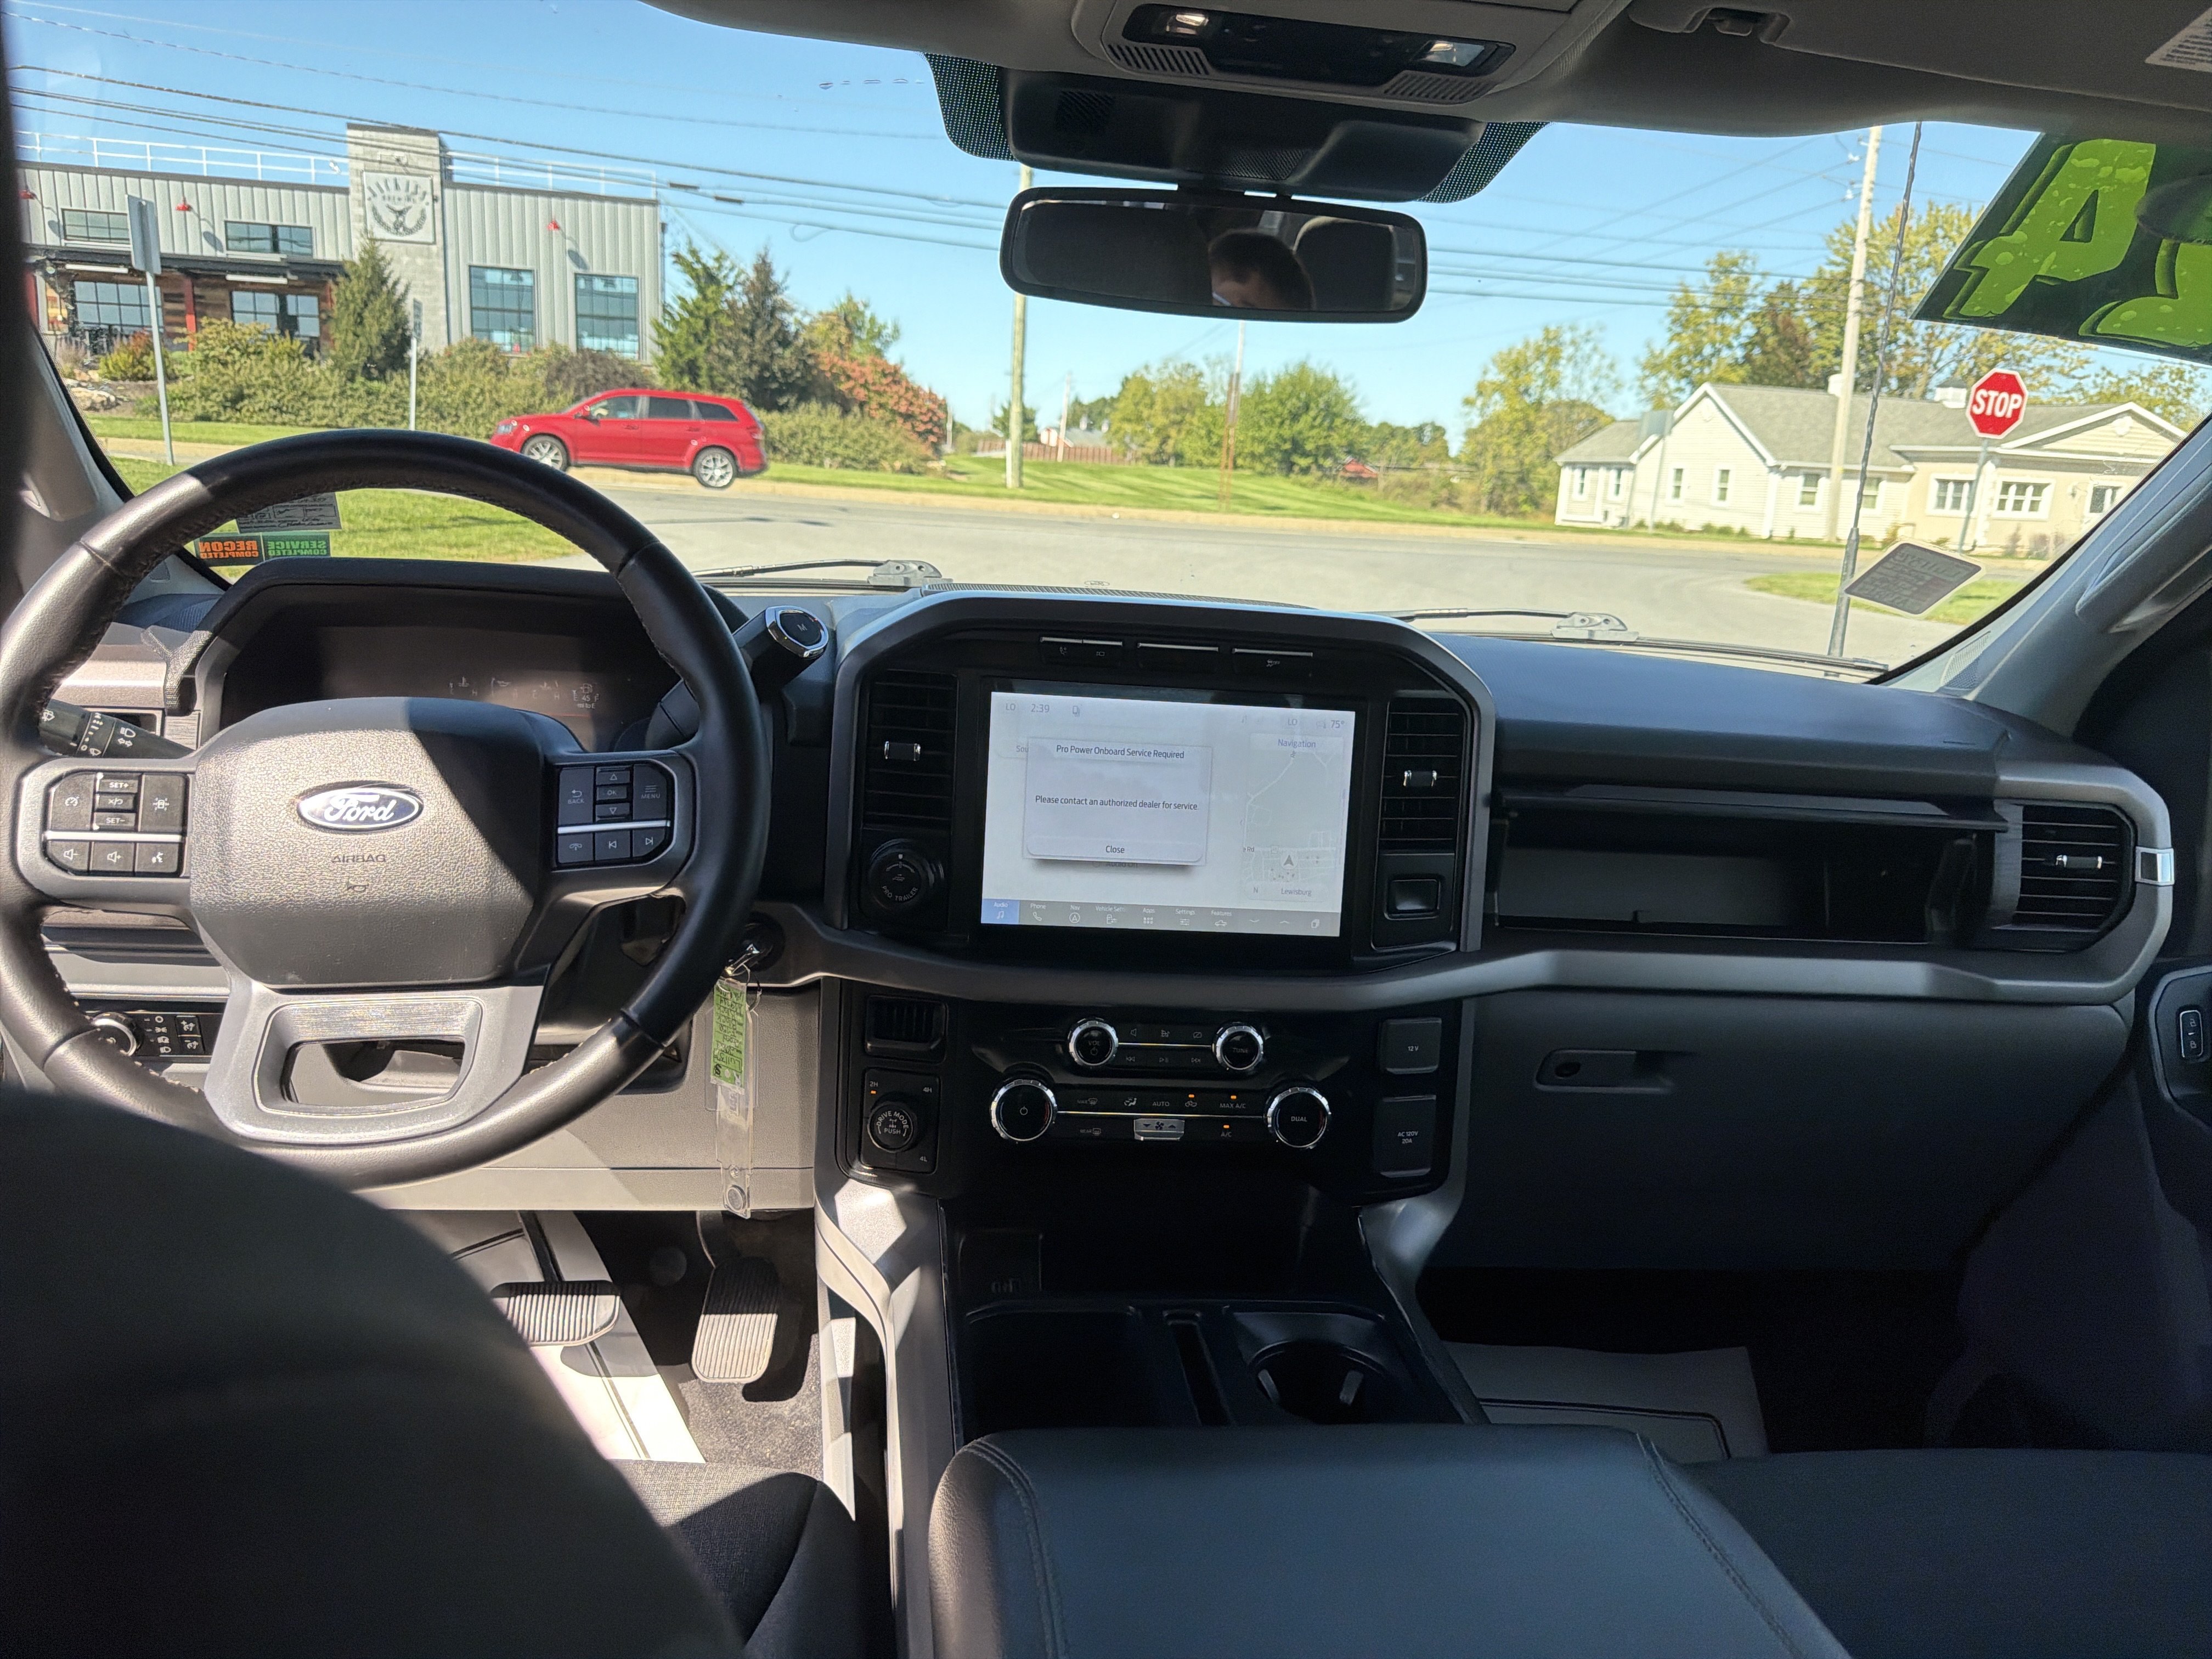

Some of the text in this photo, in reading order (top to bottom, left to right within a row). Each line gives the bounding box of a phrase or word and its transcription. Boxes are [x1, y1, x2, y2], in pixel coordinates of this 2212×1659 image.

[1972, 389, 2022, 418] STOP
[1006, 703, 1015, 711] LO
[1031, 703, 1050, 713] 2:39
[1278, 738, 1316, 748] Navigation
[1057, 744, 1184, 759] Pro Power Onboard Service Required
[324, 795, 398, 821] Ford
[1035, 795, 1059, 804] Please
[1060, 797, 1088, 805] contact
[1099, 799, 1137, 808] authorized
[1138, 800, 1161, 809] dealer
[1162, 800, 1172, 809] for
[1105, 845, 1125, 854] Close
[331, 854, 386, 863] AIRBAG
[882, 885, 918, 901] PRO TRAILER
[1281, 887, 1312, 897] Lewisburg
[876, 1110, 909, 1129] DRIVE MODE
